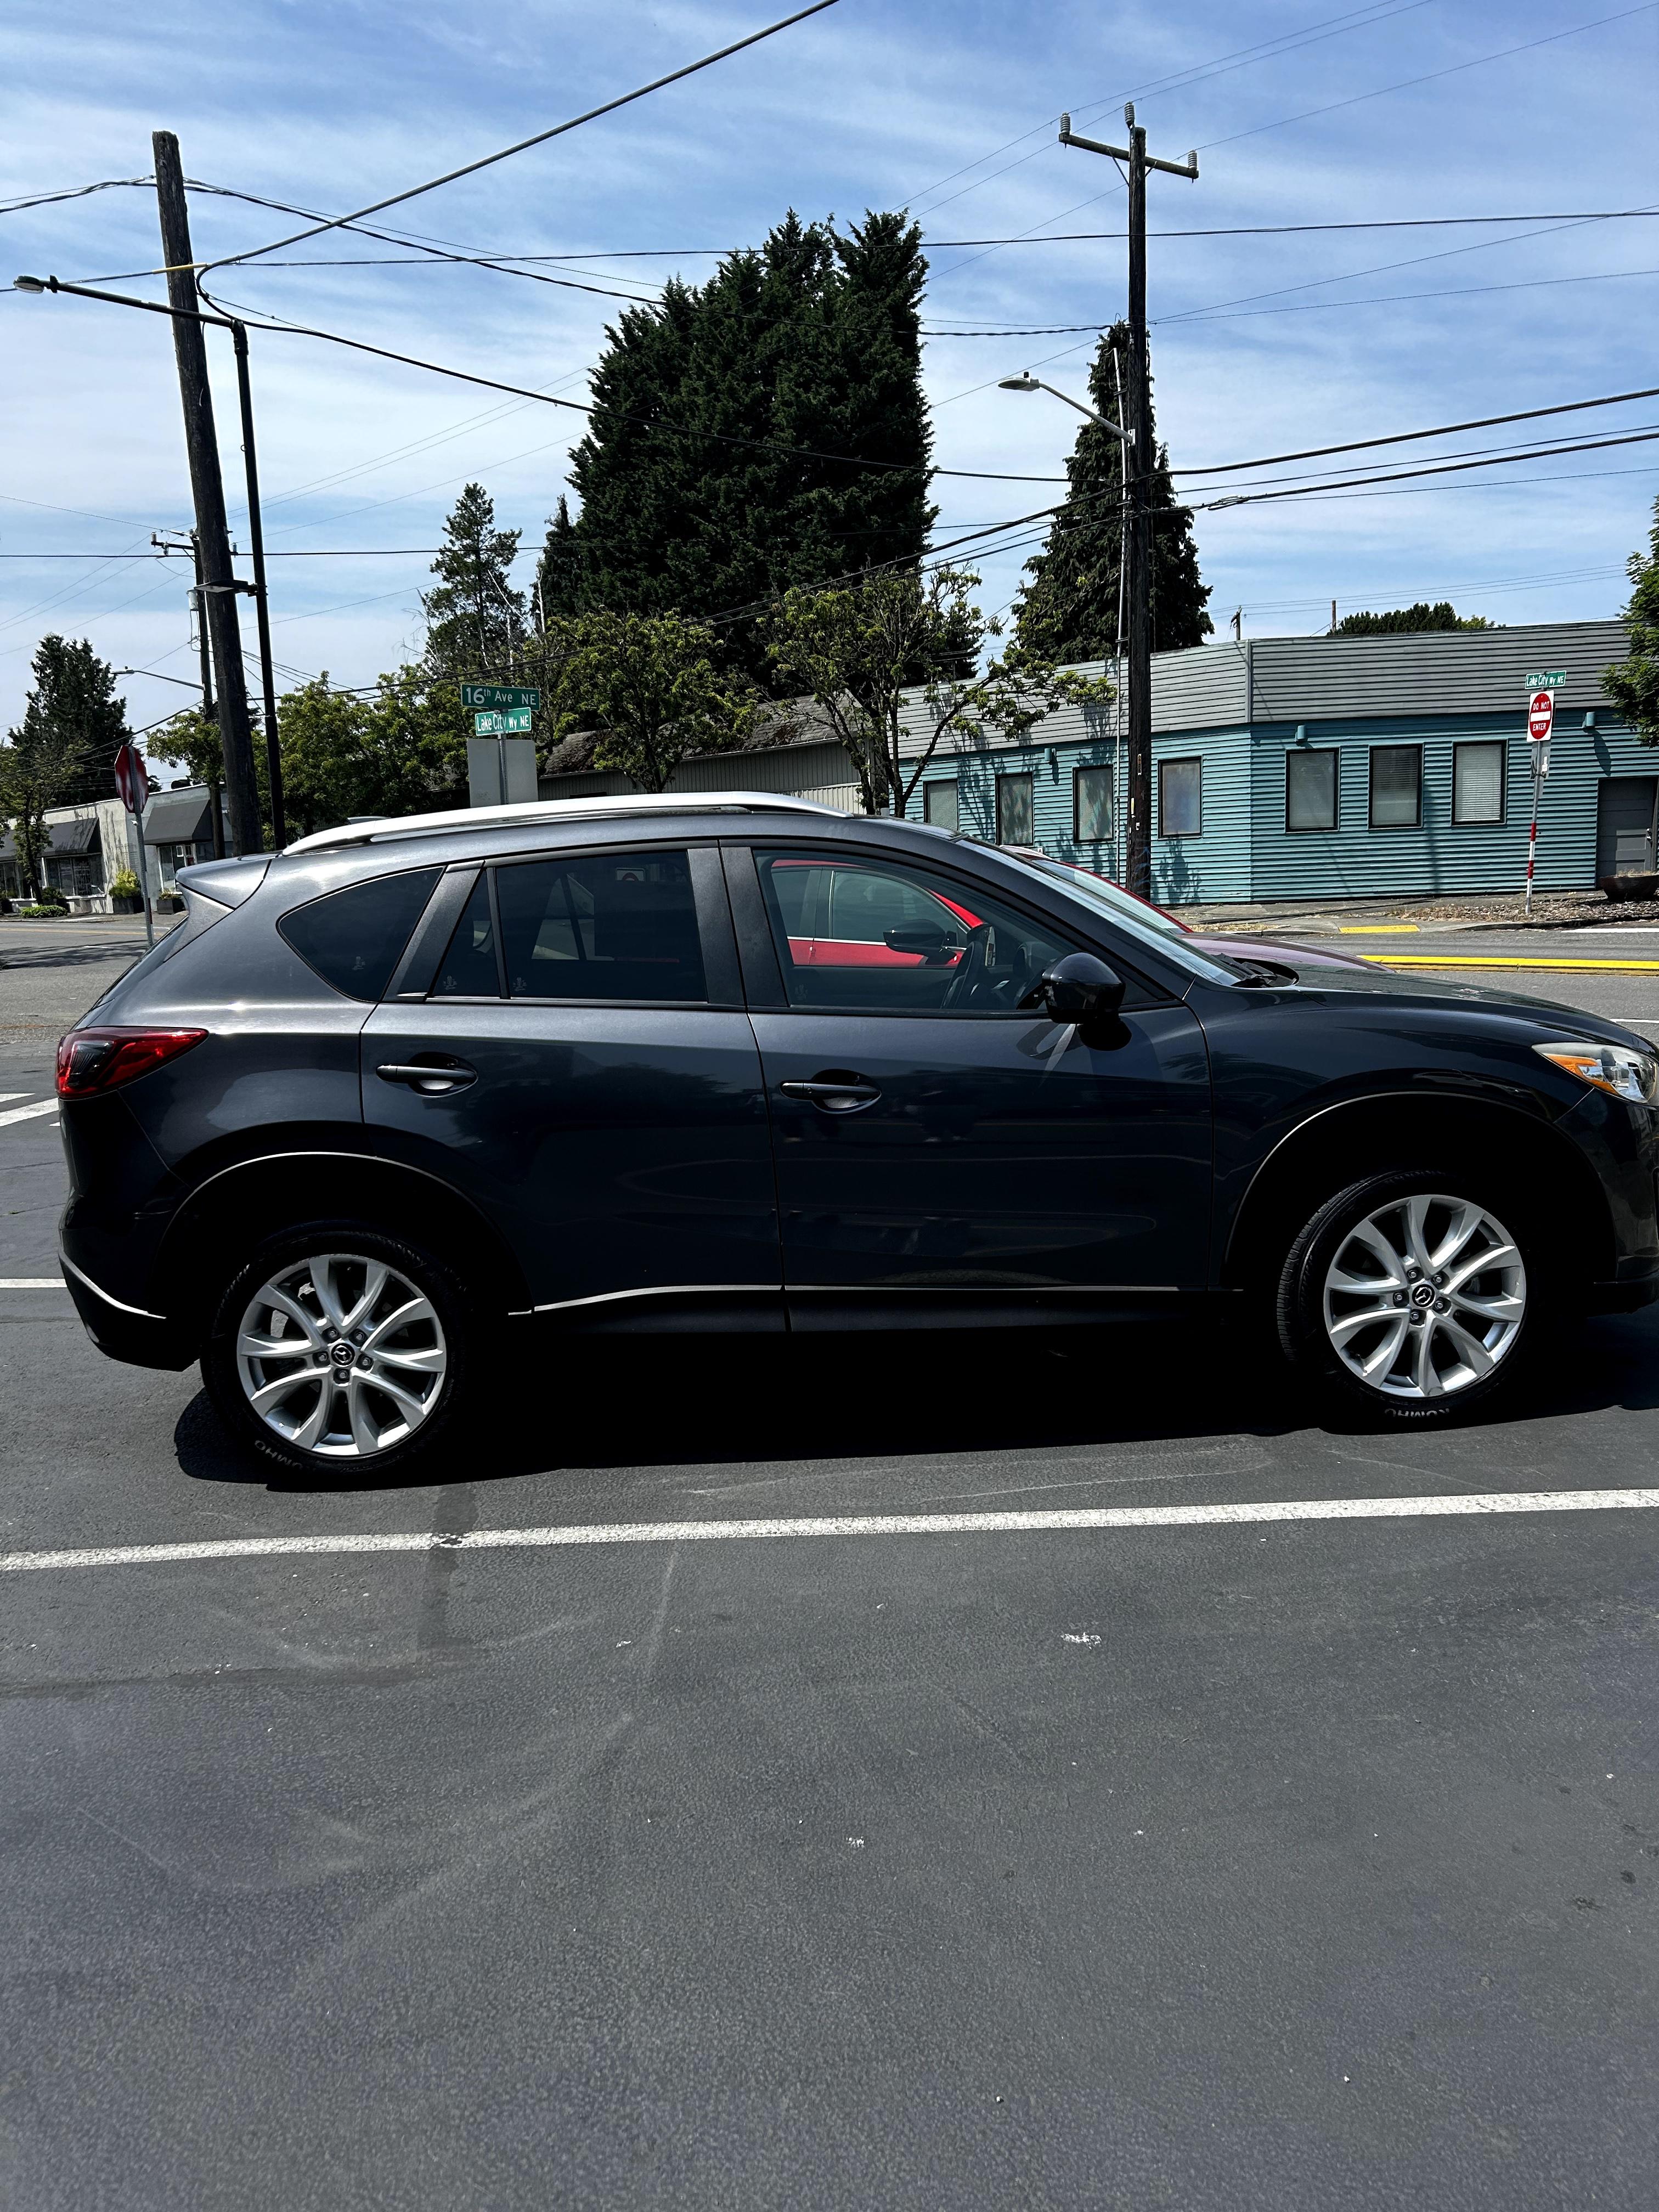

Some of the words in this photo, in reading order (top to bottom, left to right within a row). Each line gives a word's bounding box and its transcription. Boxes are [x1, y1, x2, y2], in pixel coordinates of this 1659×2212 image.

[1527, 675, 1537, 686] Lake
[1538, 675, 1548, 686] City
[1550, 677, 1556, 686] Wy
[466, 687, 491, 704] 16th
[495, 691, 512, 702] Ave
[522, 693, 536, 705] NE
[1541, 701, 1550, 709] NOT
[477, 715, 492, 732] Lake
[493, 714, 506, 731] City
[509, 717, 517, 730] Wy
[520, 715, 529, 727] NE
[1532, 723, 1546, 731] ENTER
